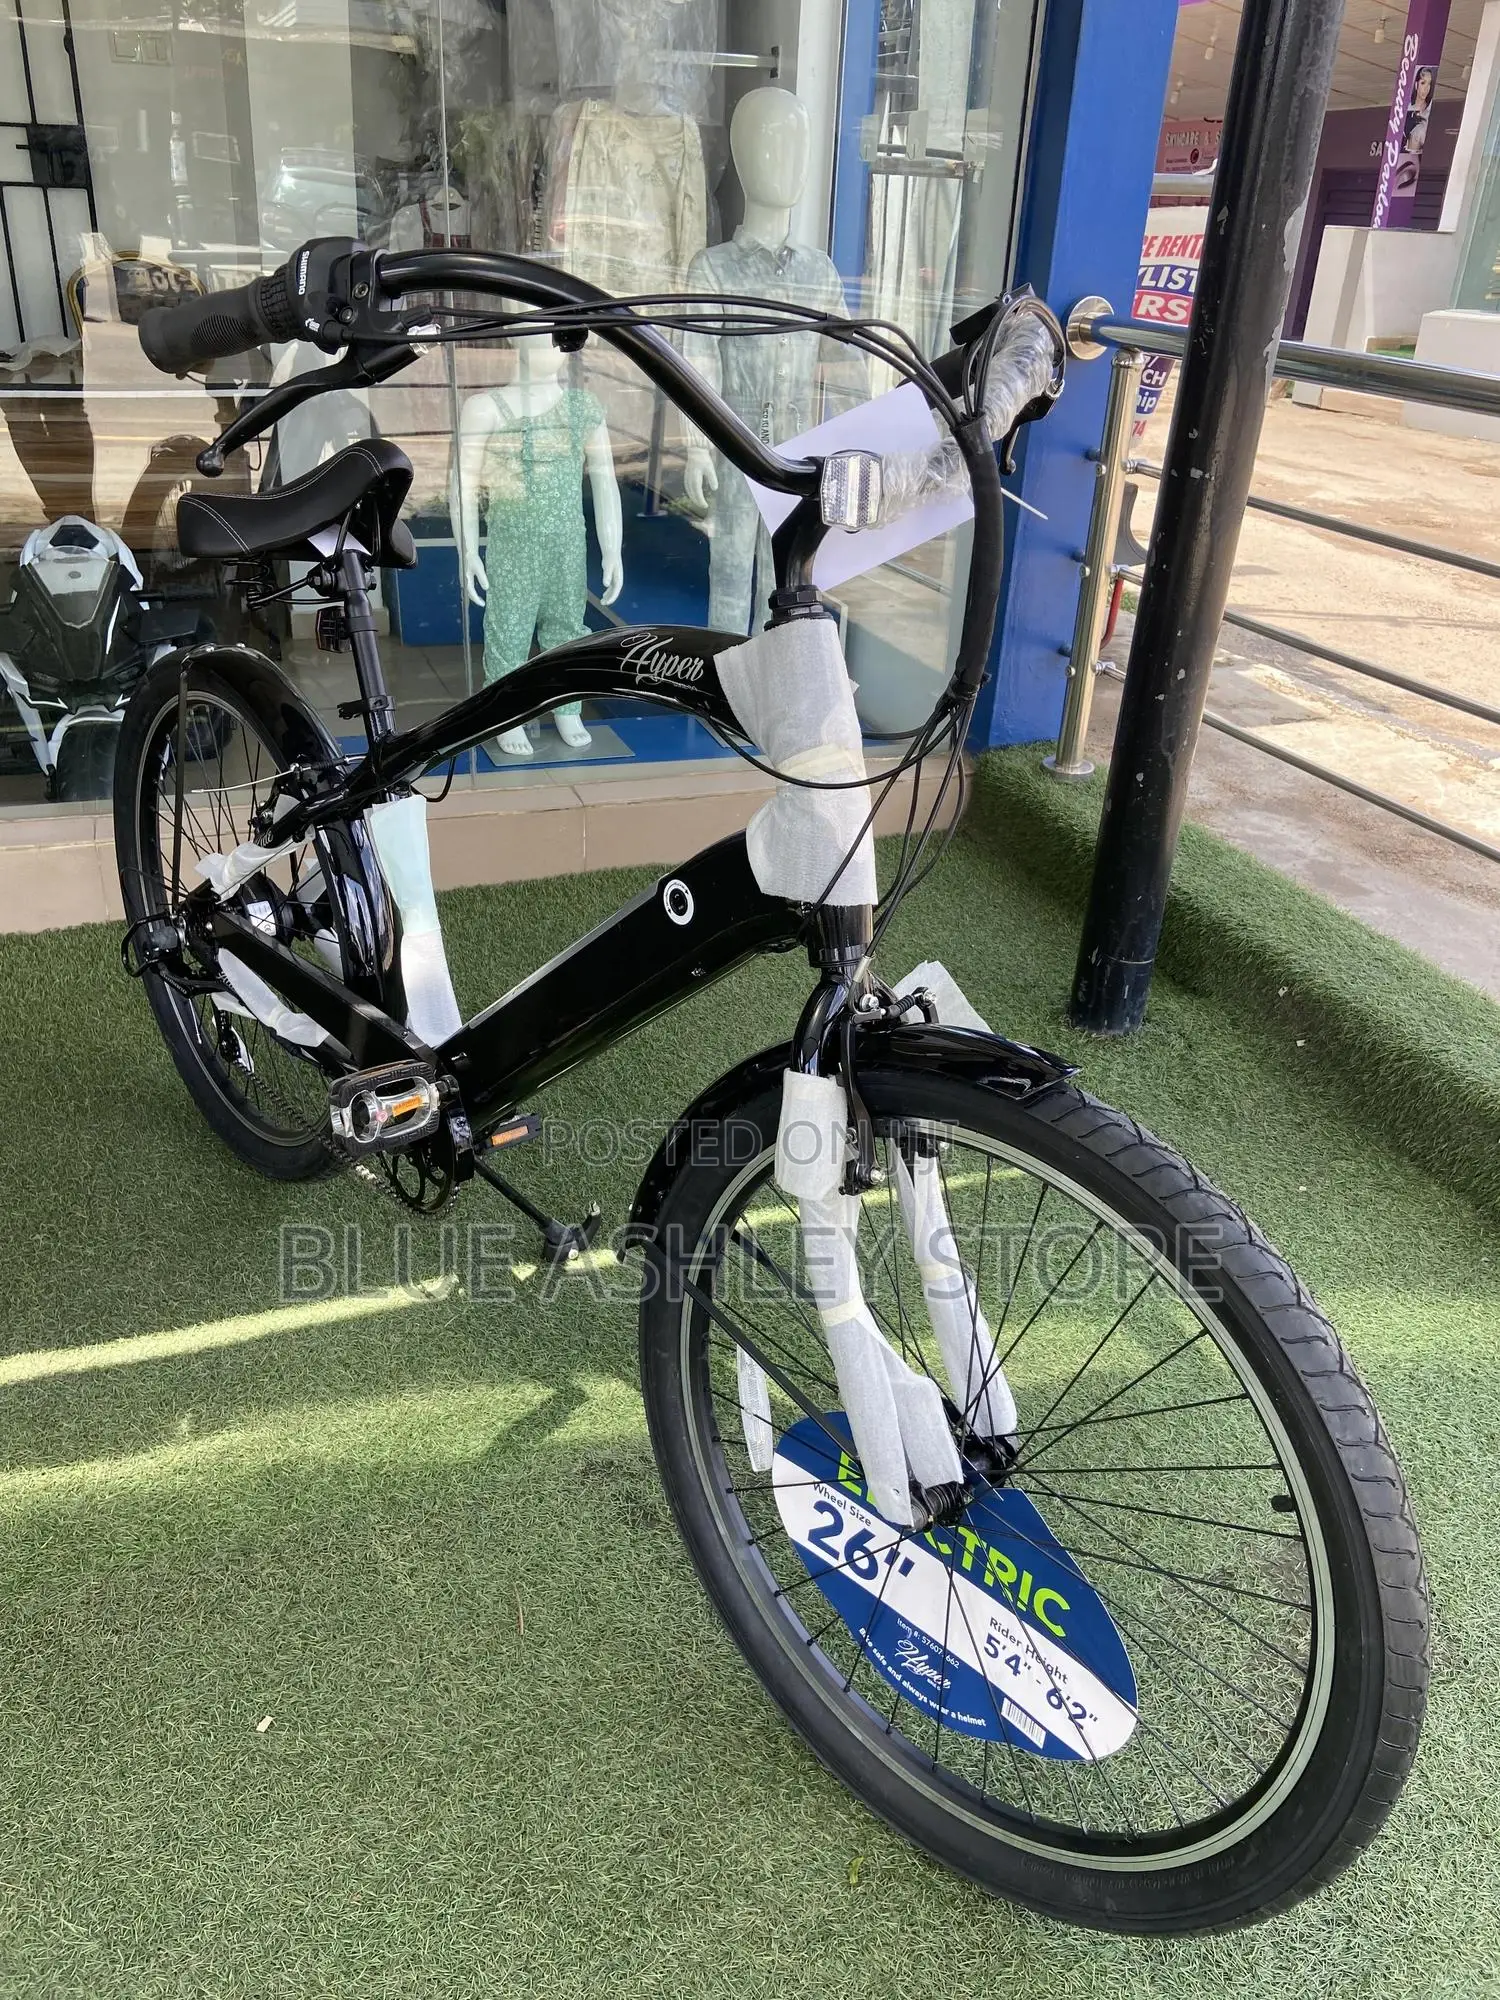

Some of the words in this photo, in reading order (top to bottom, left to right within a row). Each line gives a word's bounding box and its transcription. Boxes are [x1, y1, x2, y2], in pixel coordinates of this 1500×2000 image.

[298, 250, 310, 295] SHIMANO
[812, 1483, 847, 1510] Wheel
[849, 1505, 872, 1527] Size
[990, 1616, 1022, 1647] Rider
[1025, 1644, 1069, 1684] Height
[872, 1647, 887, 1666] safe
[887, 1665, 902, 1681] and
[902, 1680, 928, 1704] always
[950, 1710, 958, 1719] a
[957, 1711, 987, 1727] helmet
